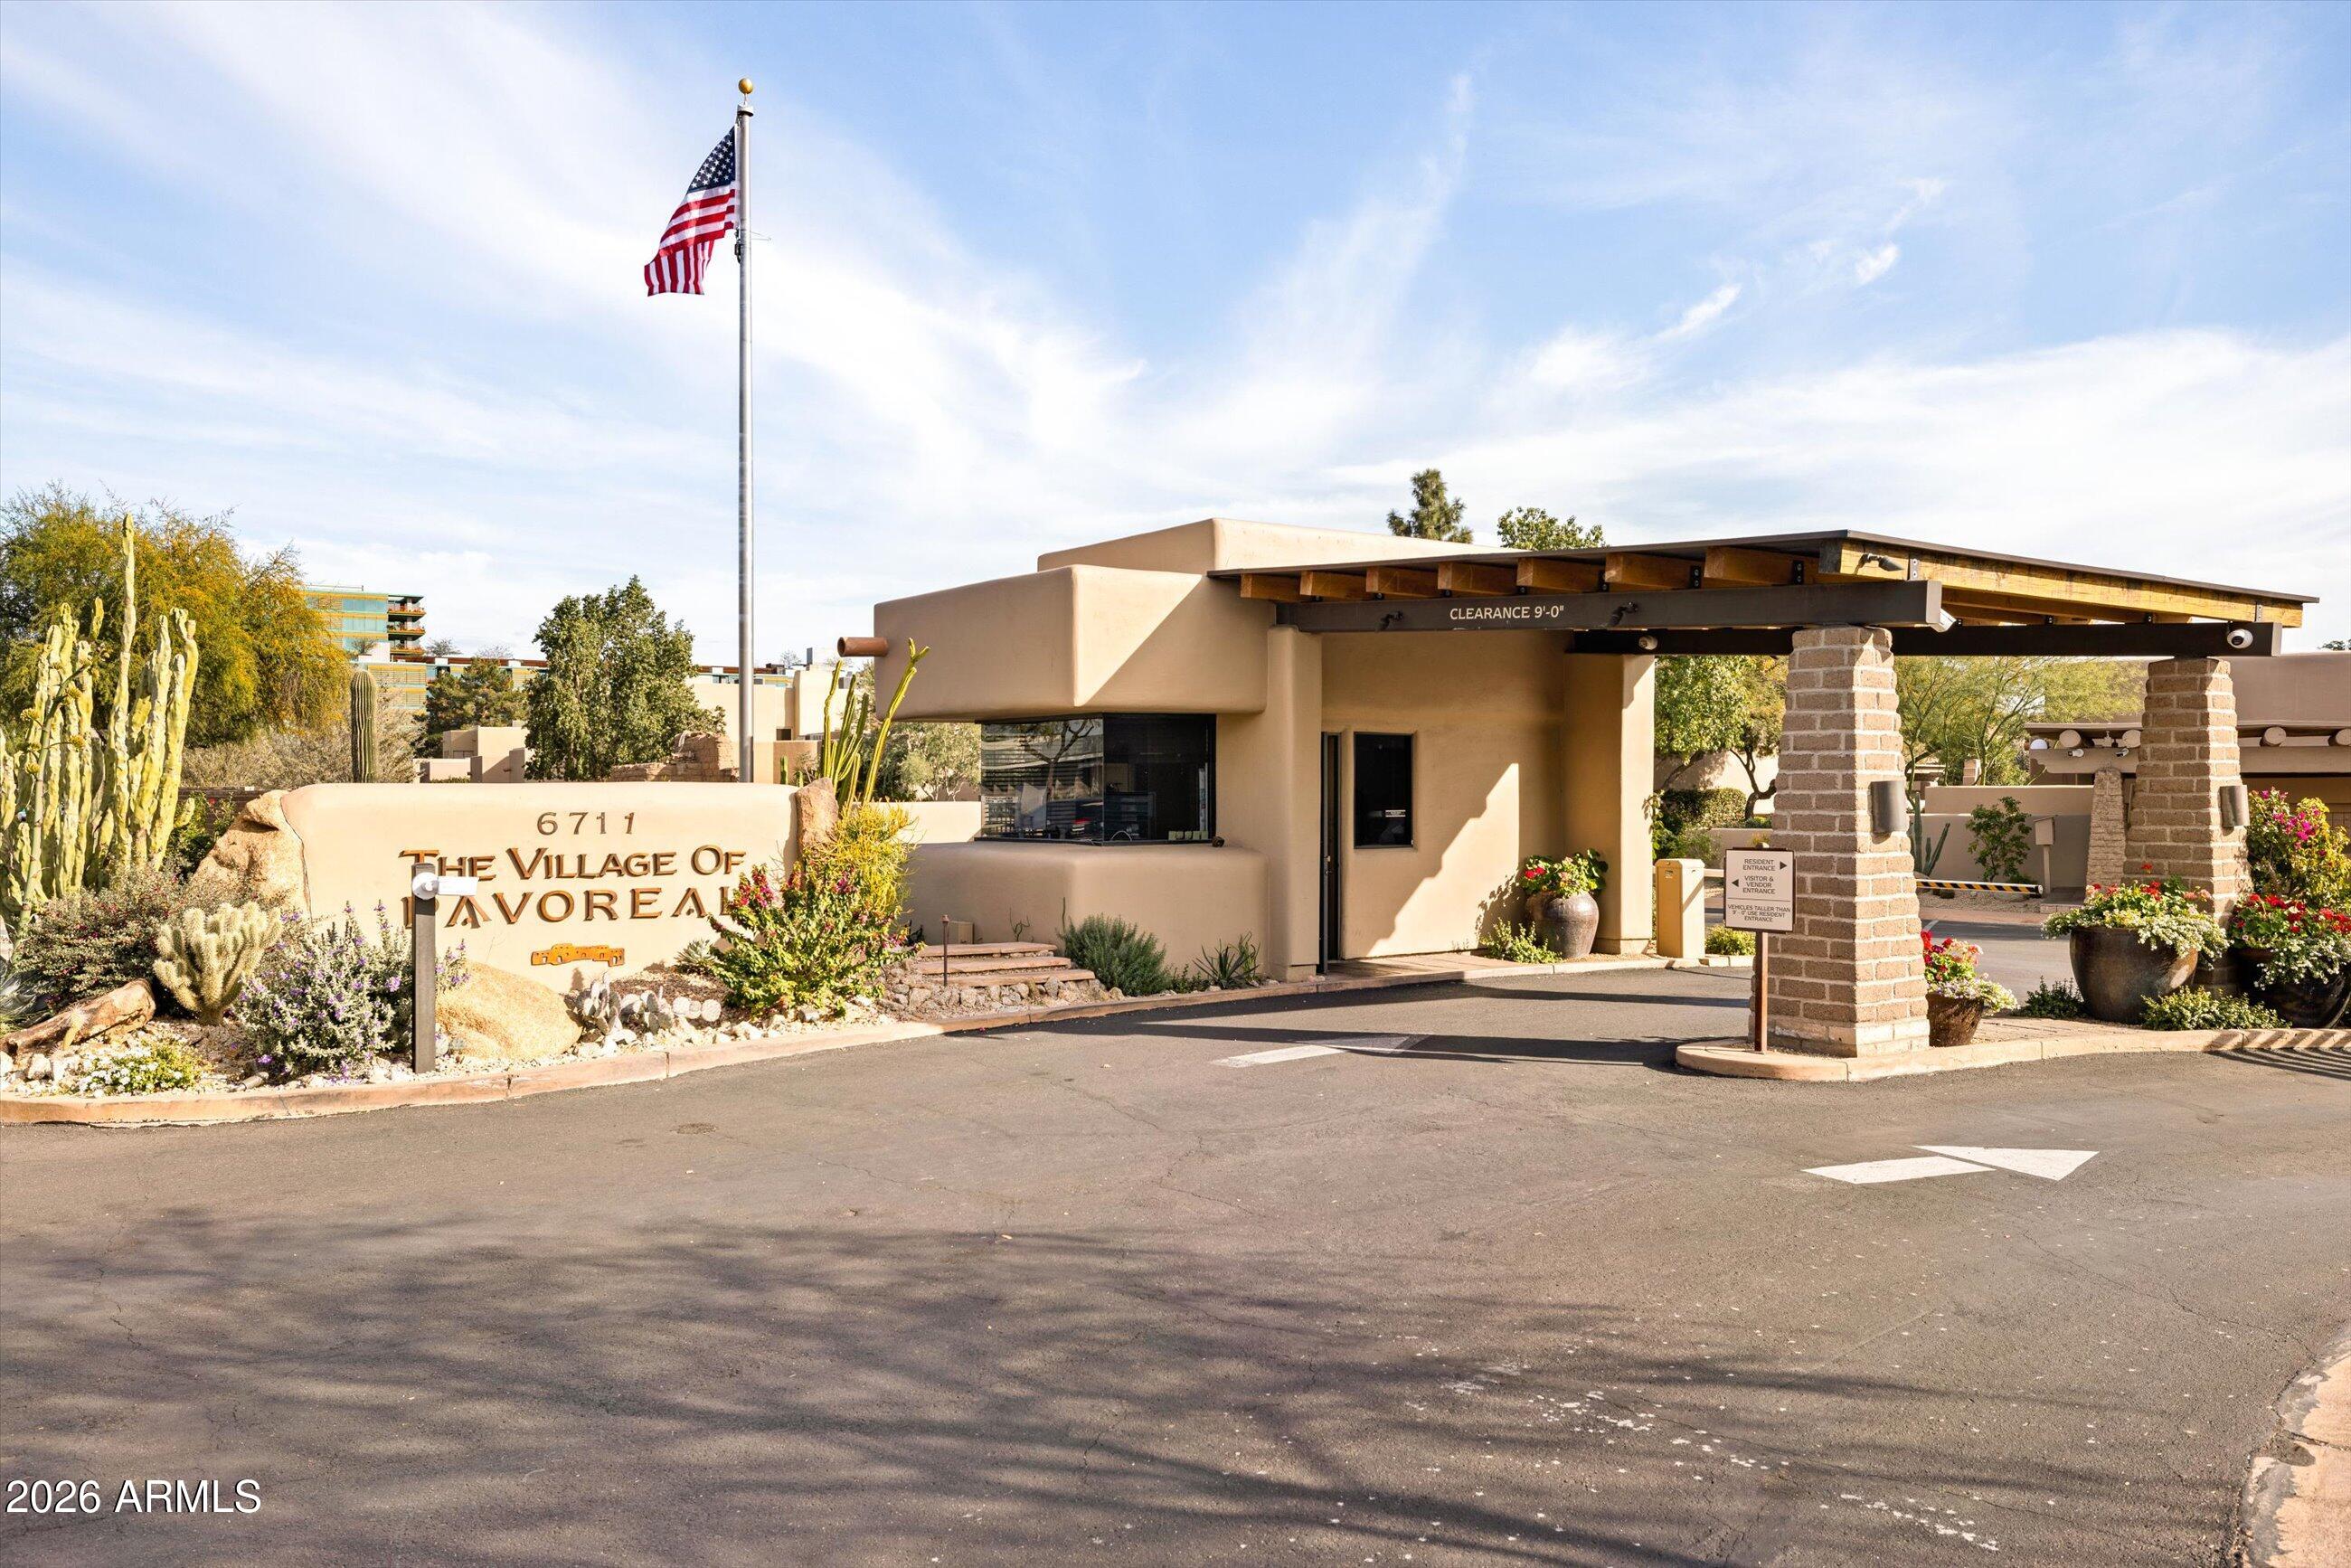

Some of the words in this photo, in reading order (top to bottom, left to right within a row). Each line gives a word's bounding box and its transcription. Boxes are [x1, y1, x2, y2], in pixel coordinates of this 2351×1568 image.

[1449, 606, 1530, 620] CLEARANCE
[1534, 605, 1565, 619] 9'-0"
[536, 811, 636, 836] 6711
[398, 849, 496, 882] THE
[505, 847, 678, 880] VILLAGE
[690, 844, 747, 876] OF
